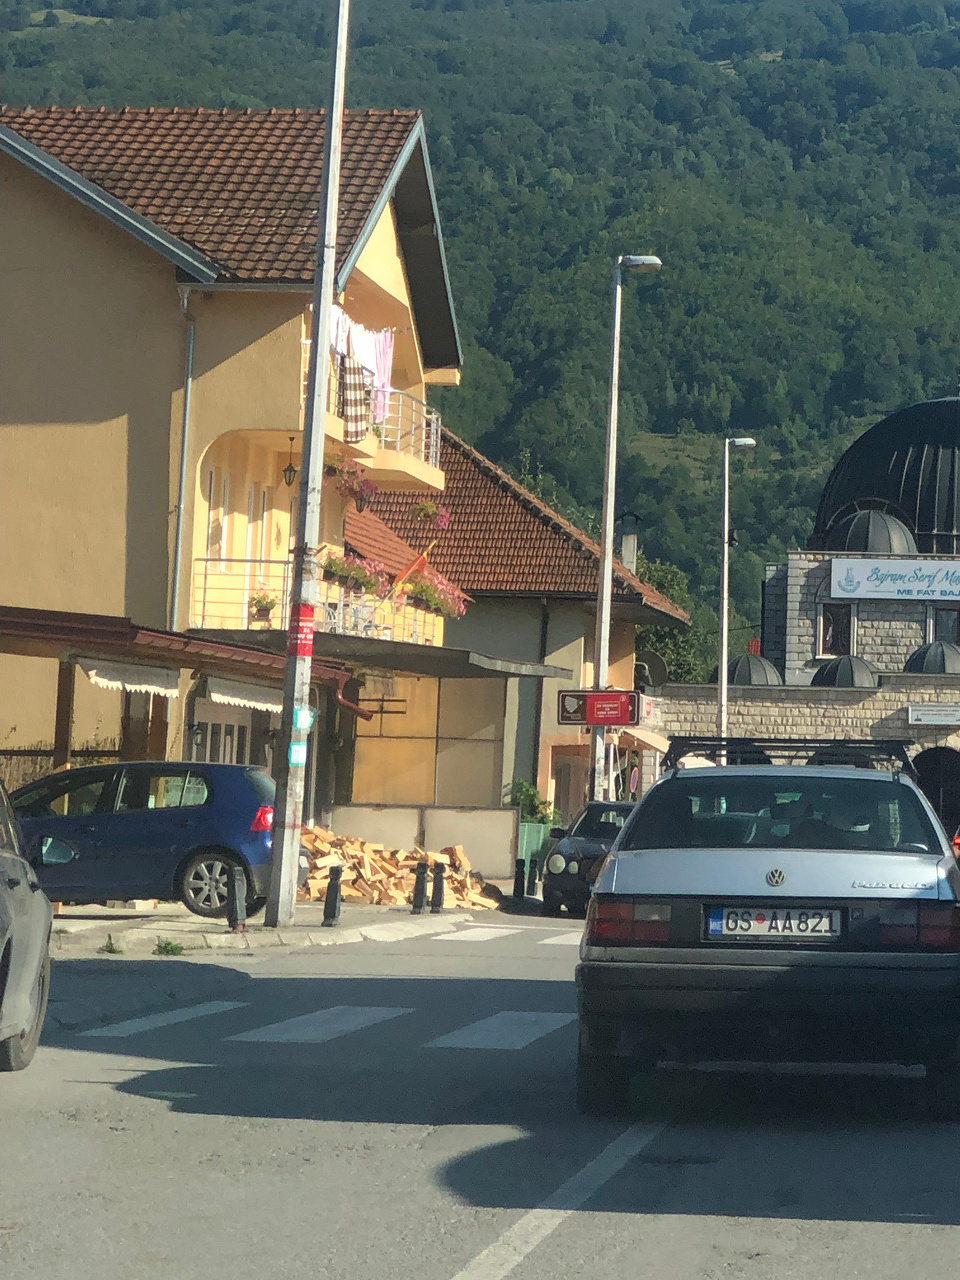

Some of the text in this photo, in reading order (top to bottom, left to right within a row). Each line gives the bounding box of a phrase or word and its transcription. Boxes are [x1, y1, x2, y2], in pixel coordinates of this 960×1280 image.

[867, 567, 907, 588] Bajram
[725, 910, 837, 933] GS AA821
